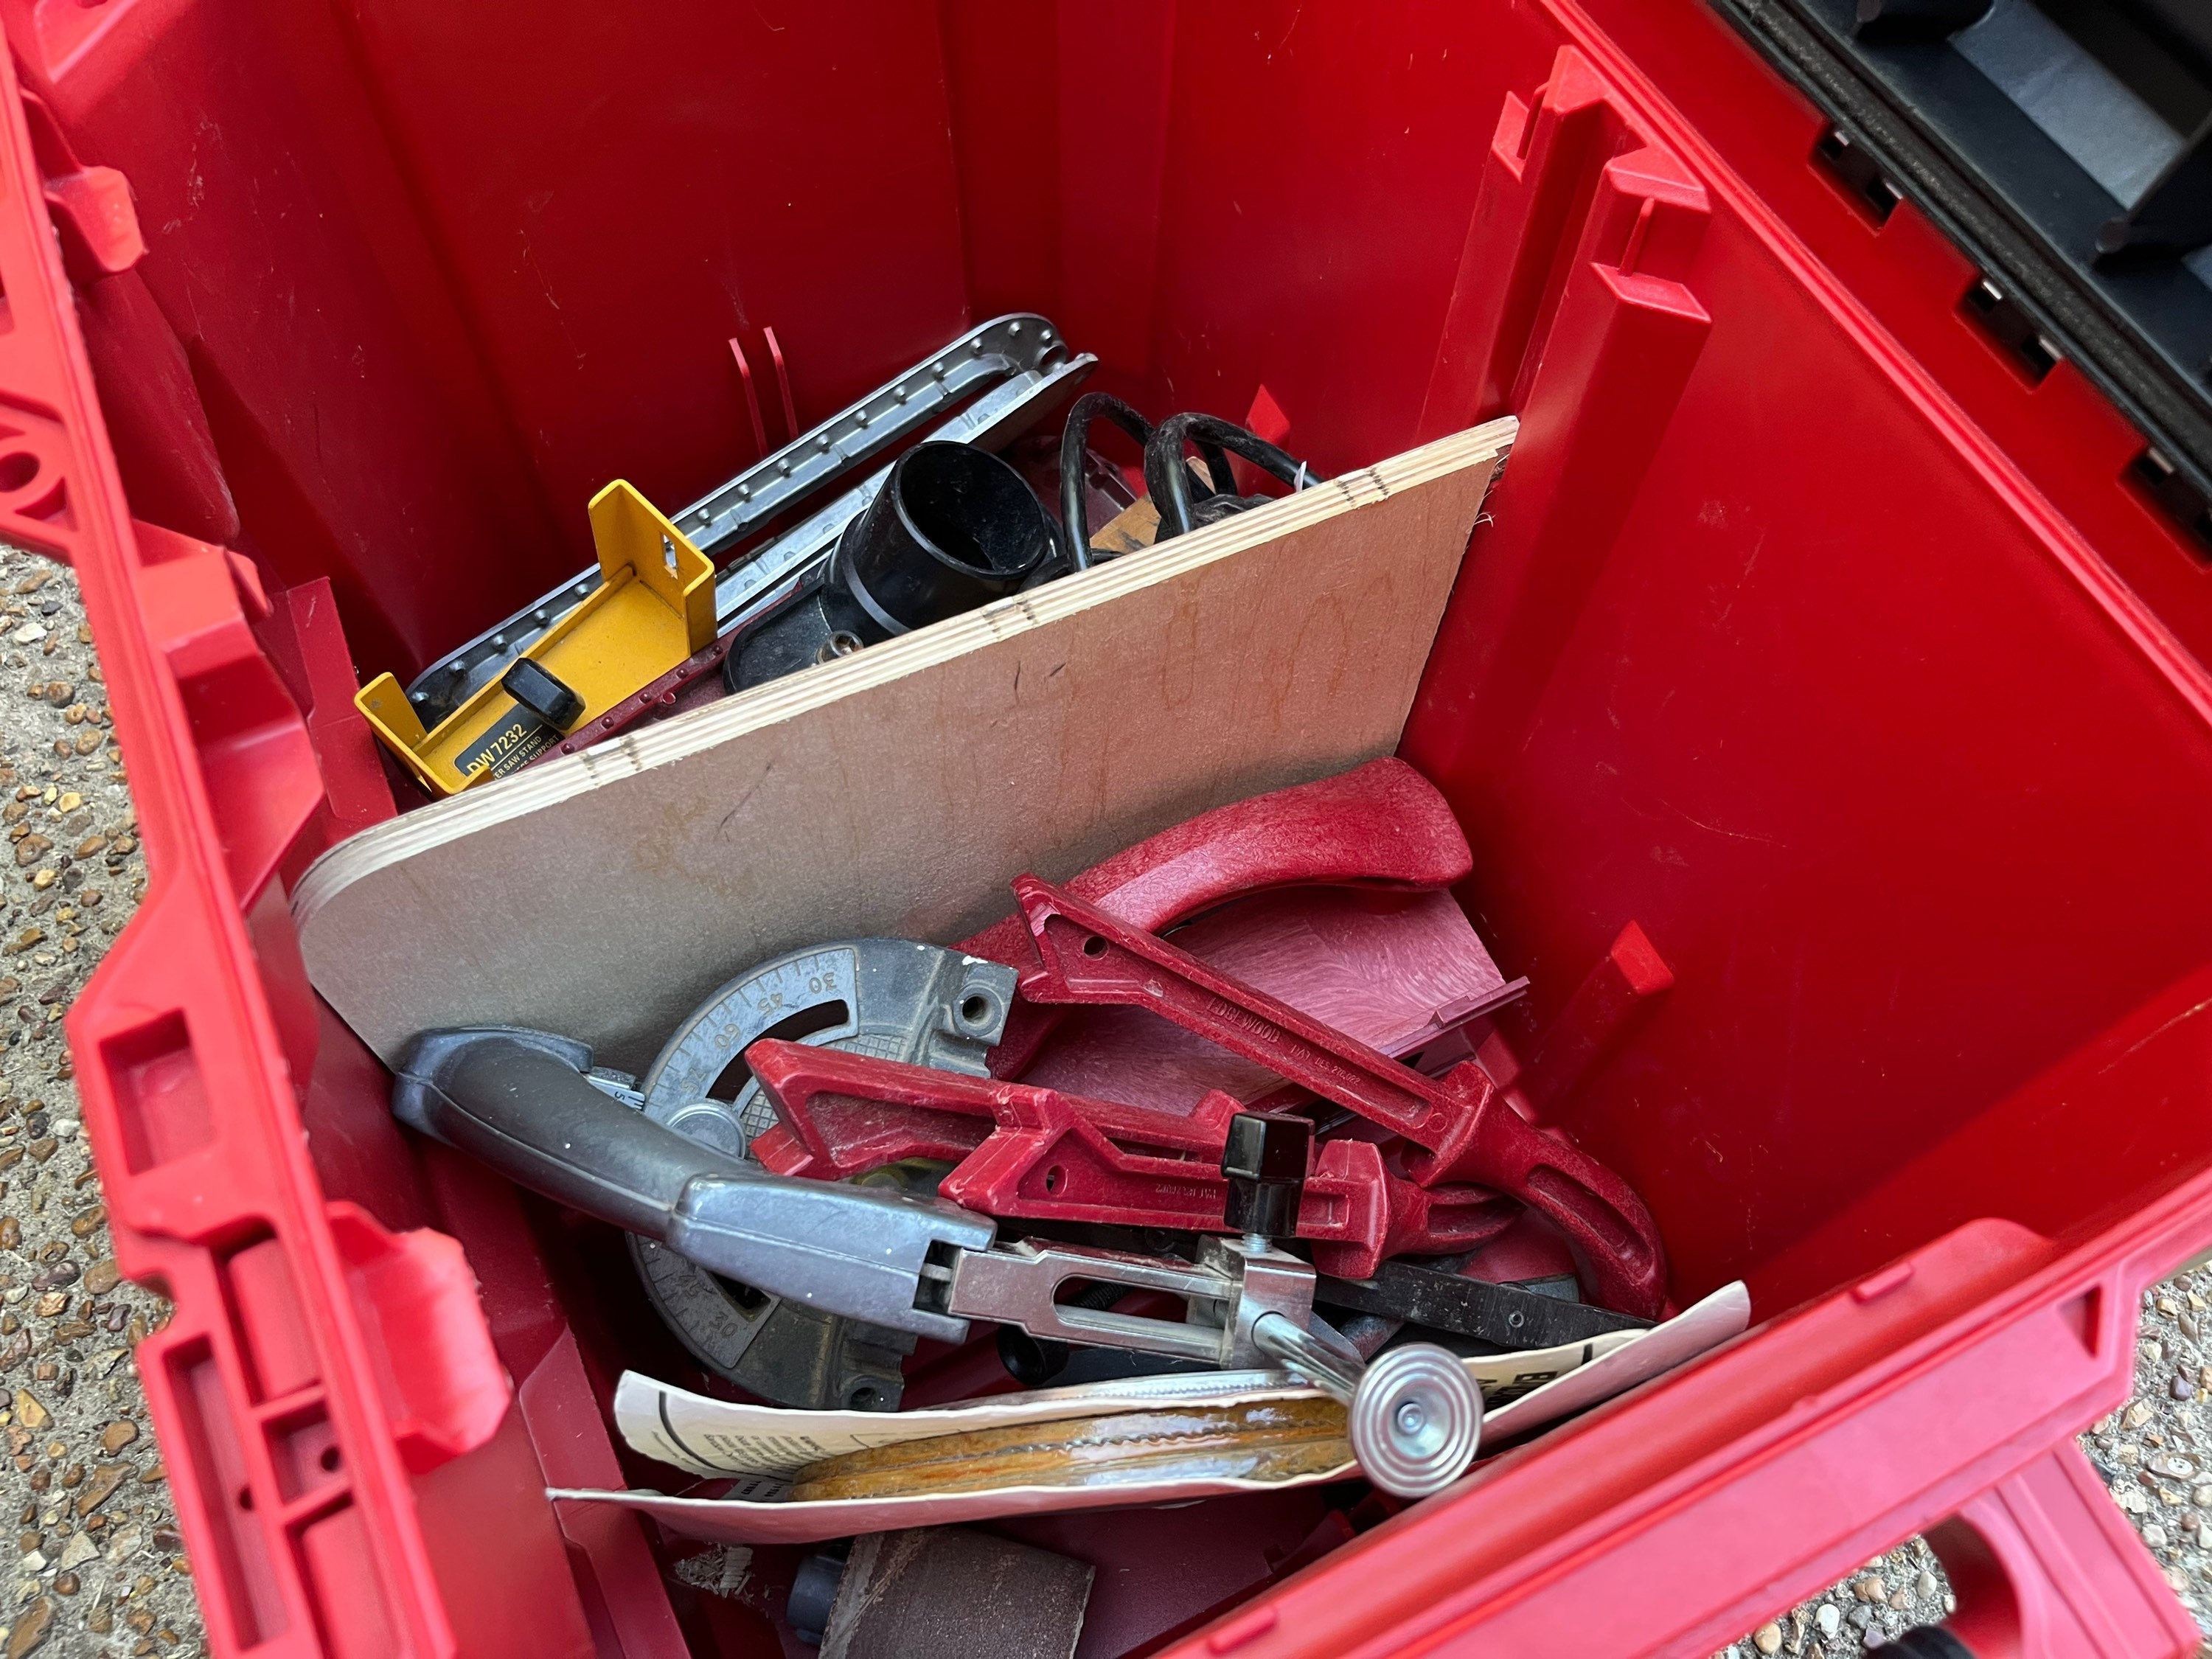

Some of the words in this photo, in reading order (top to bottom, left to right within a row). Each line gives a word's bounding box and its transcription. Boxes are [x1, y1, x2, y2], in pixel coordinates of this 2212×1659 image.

[504, 755, 521, 771] SAW
[521, 735, 542, 757] STAND
[529, 734, 560, 761] SUPPORT
[809, 972, 837, 994] 30
[757, 992, 783, 1015] 45
[714, 1023, 742, 1050] 60
[681, 1068, 706, 1094] 75
[709, 1311, 738, 1338] 30
